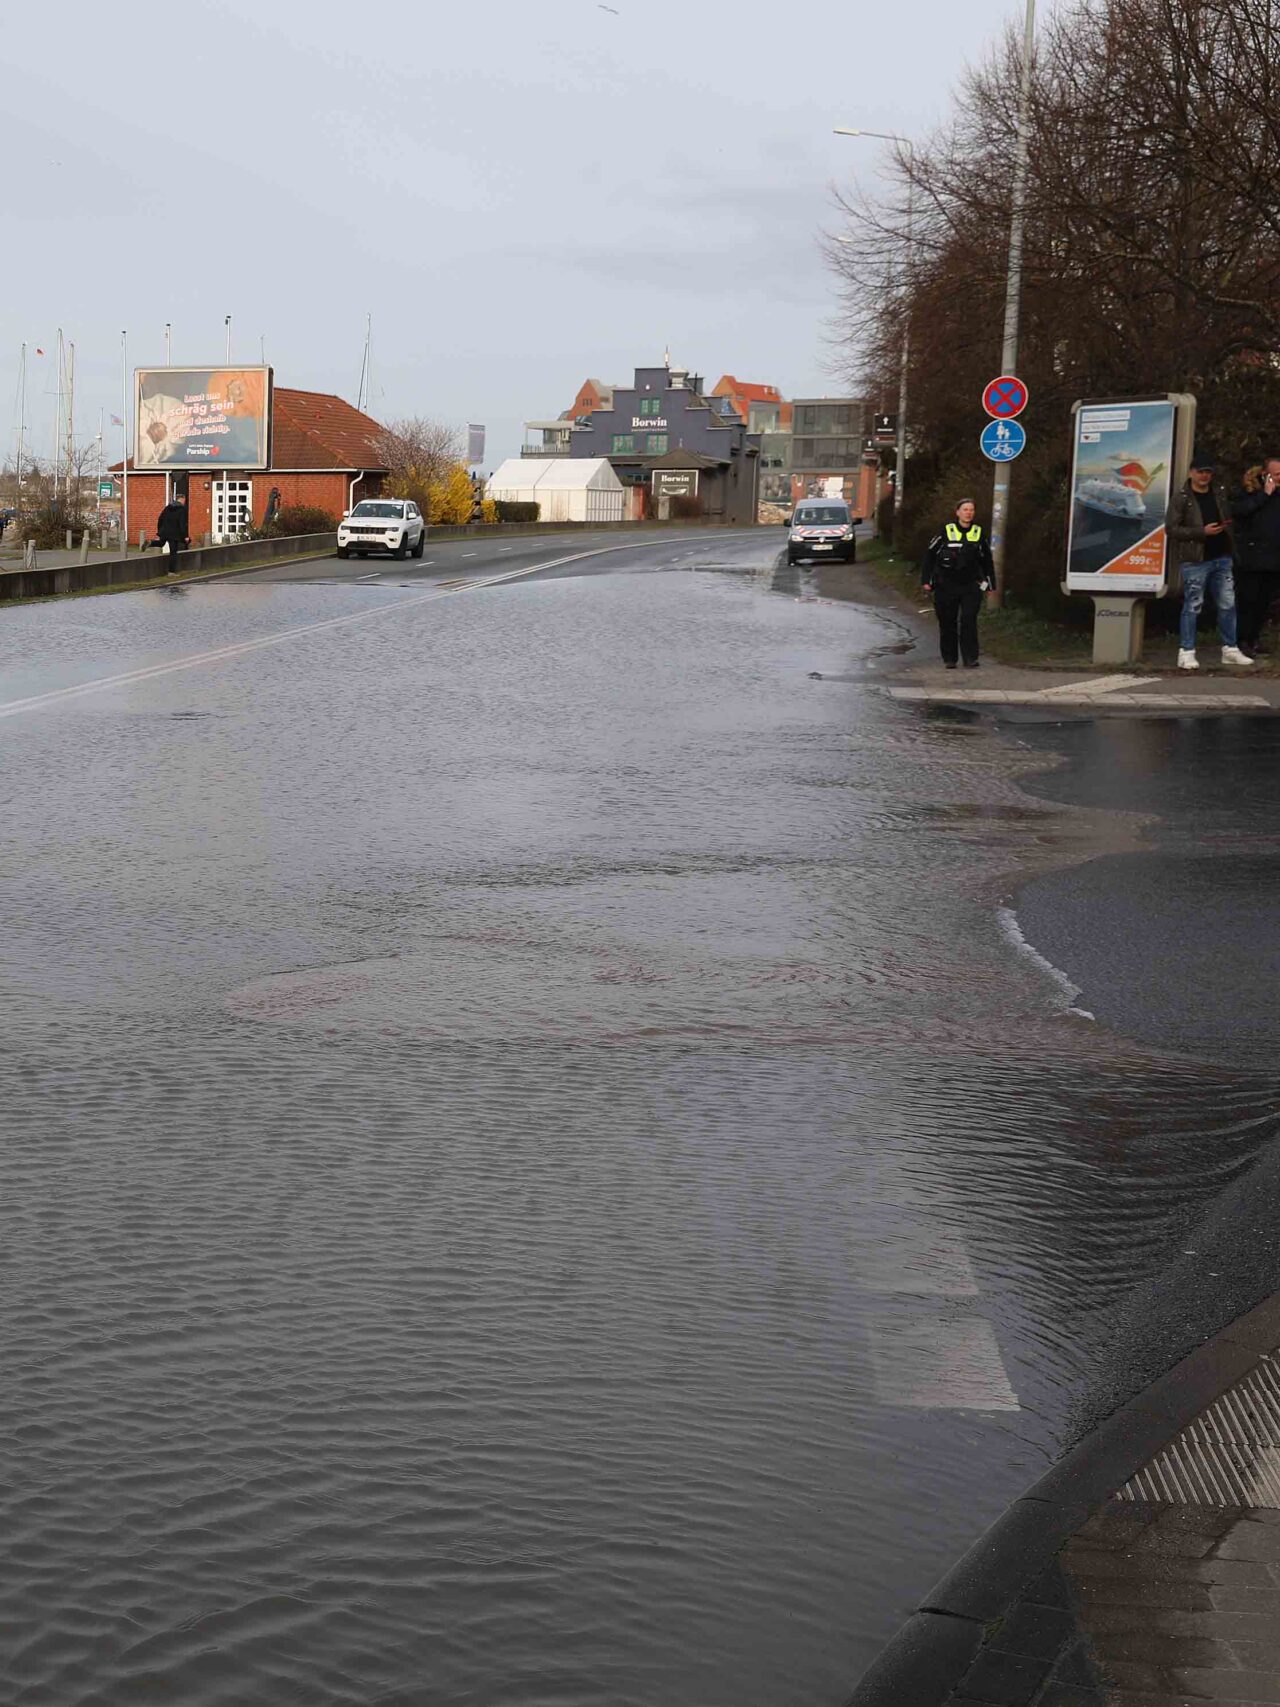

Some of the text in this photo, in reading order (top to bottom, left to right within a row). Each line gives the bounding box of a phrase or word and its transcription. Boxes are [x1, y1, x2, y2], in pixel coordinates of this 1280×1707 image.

[206, 392, 221, 401] uns
[169, 399, 235, 417] schräg sein
[632, 416, 668, 427] Borwin
[186, 447, 210, 456] Parship
[661, 474, 690, 482] Borwin
